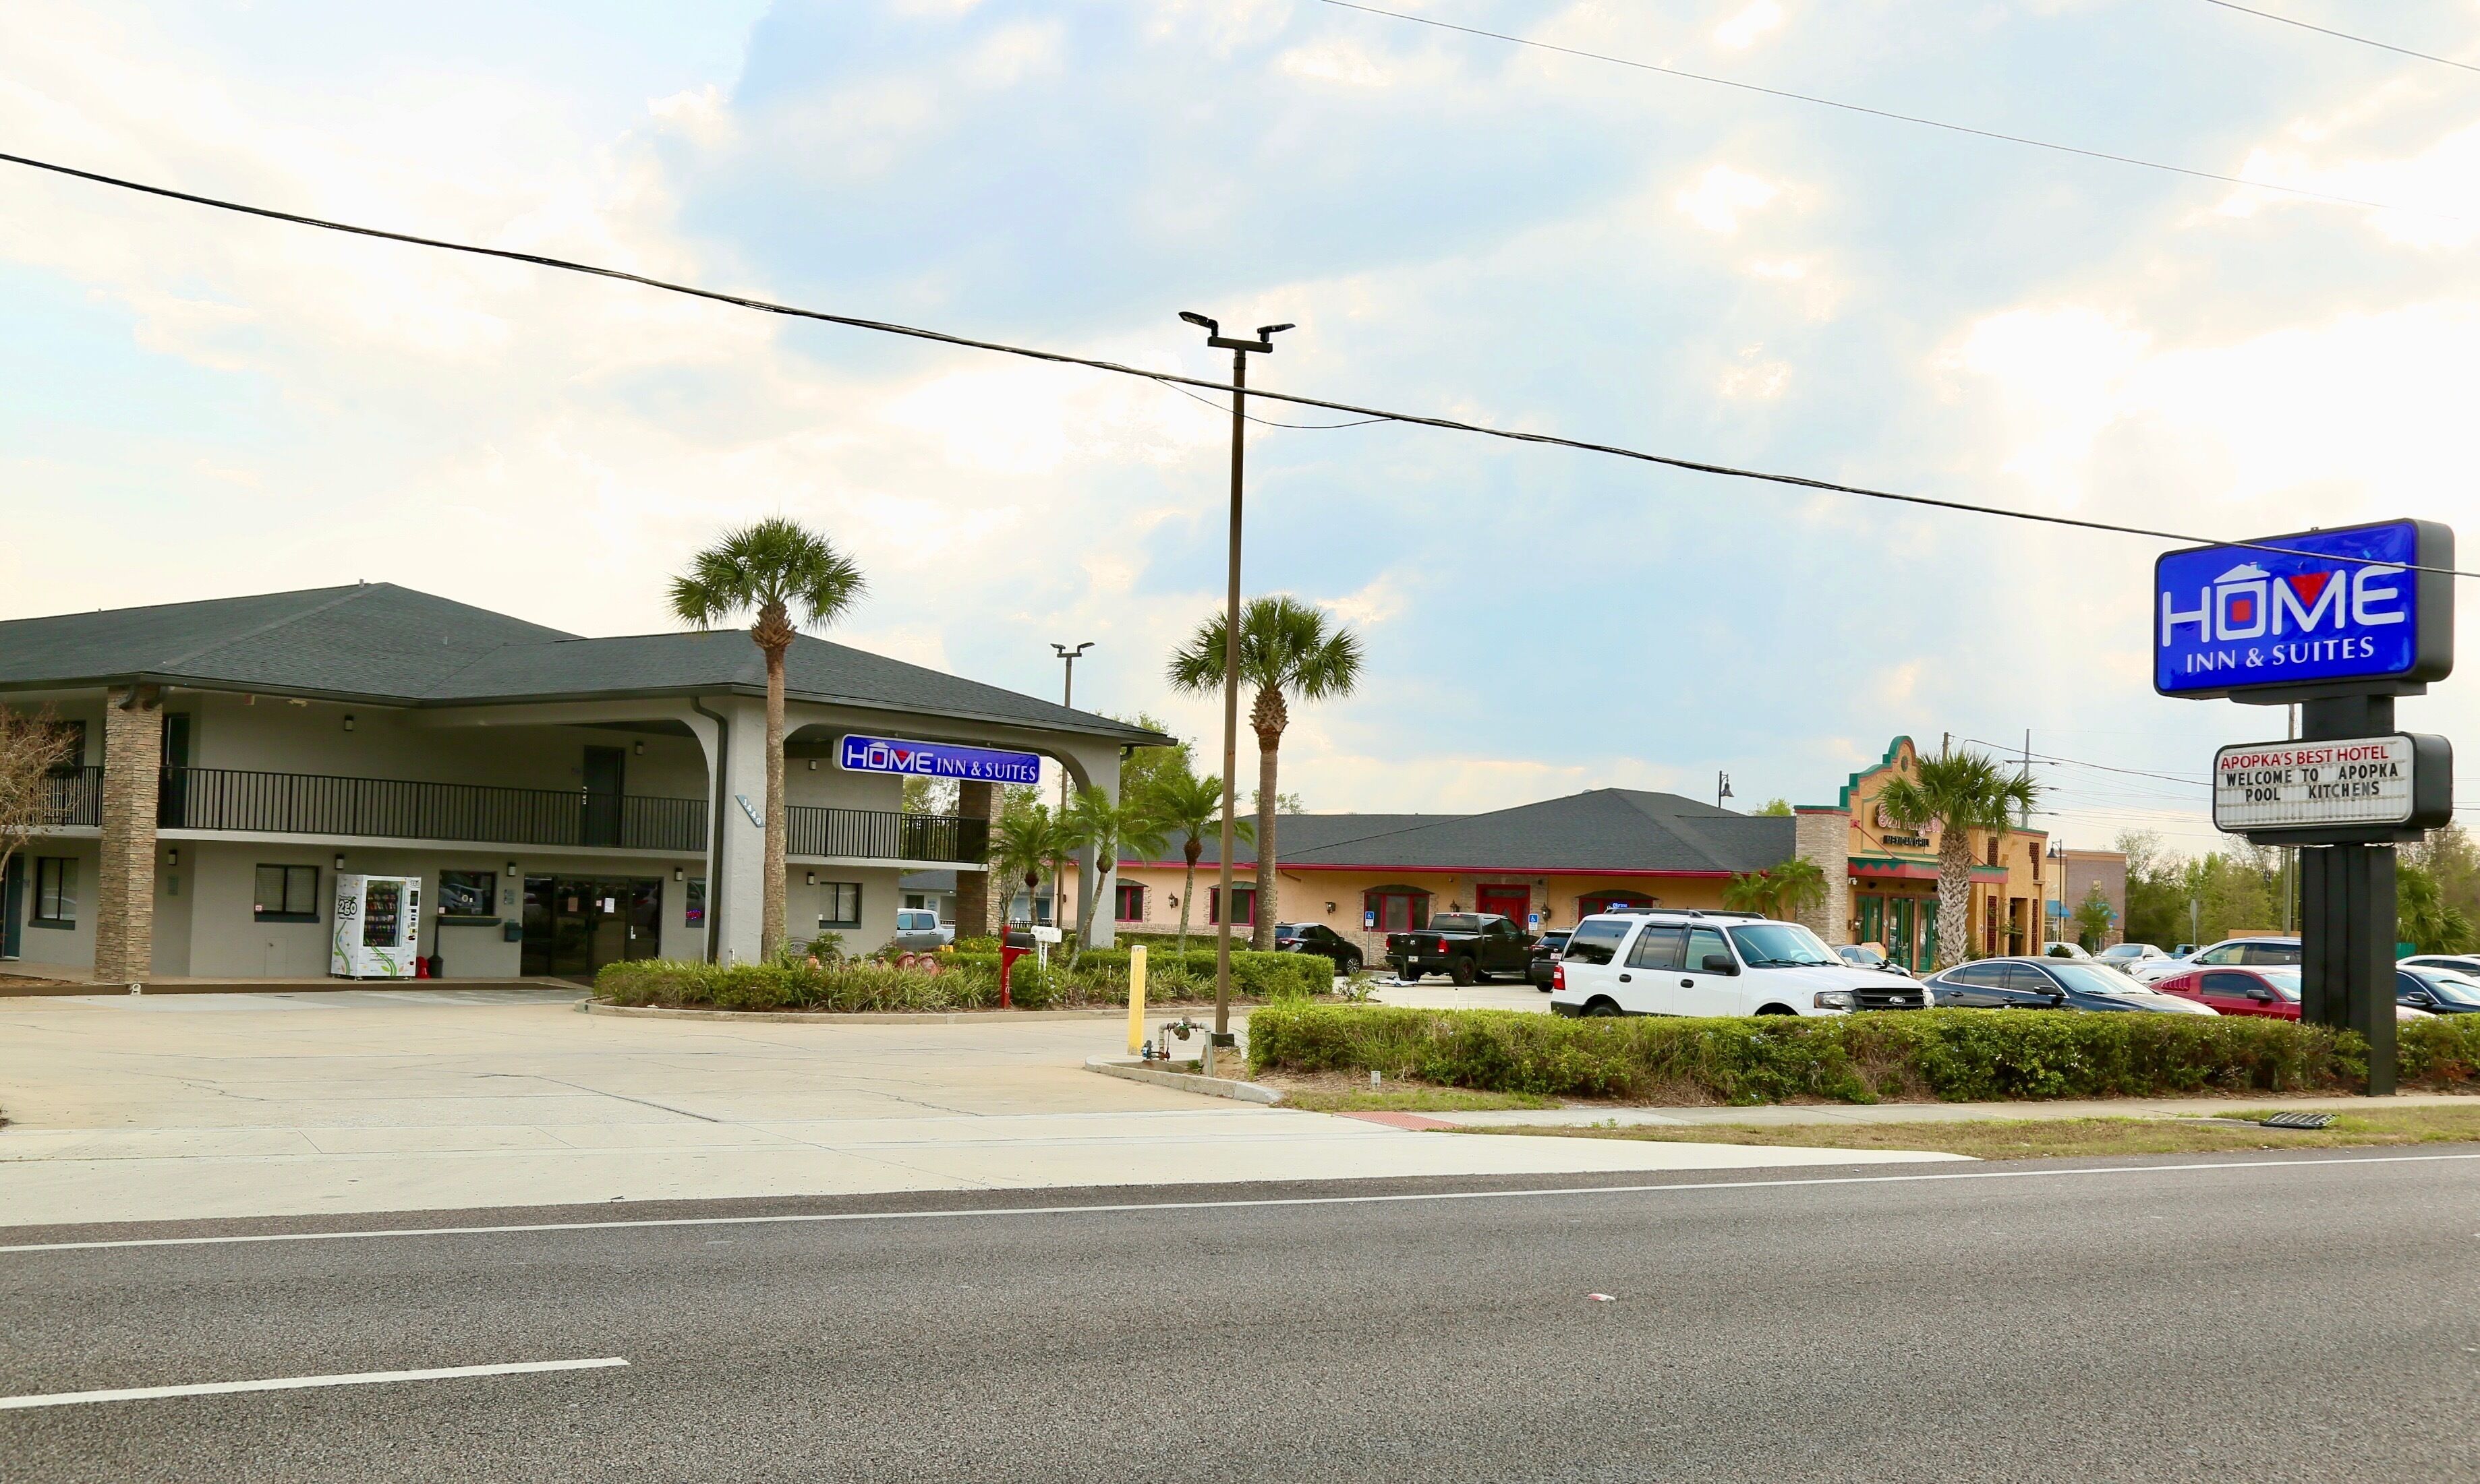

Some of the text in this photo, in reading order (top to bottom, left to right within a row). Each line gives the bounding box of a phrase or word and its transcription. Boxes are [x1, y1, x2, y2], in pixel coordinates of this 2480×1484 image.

[2162, 562, 2406, 647] HOME
[2187, 636, 2374, 673] INN & SUITES
[847, 744, 1036, 781] HOME INN & SUITES
[2221, 745, 2388, 770] APOPKA'S BEST HOTEL
[2226, 763, 2398, 787] WELCOME TO APOPKA
[2245, 781, 2380, 802] POOL KITCHENS
[743, 798, 761, 825] 1440
[1886, 836, 1913, 846] MEXICAN
